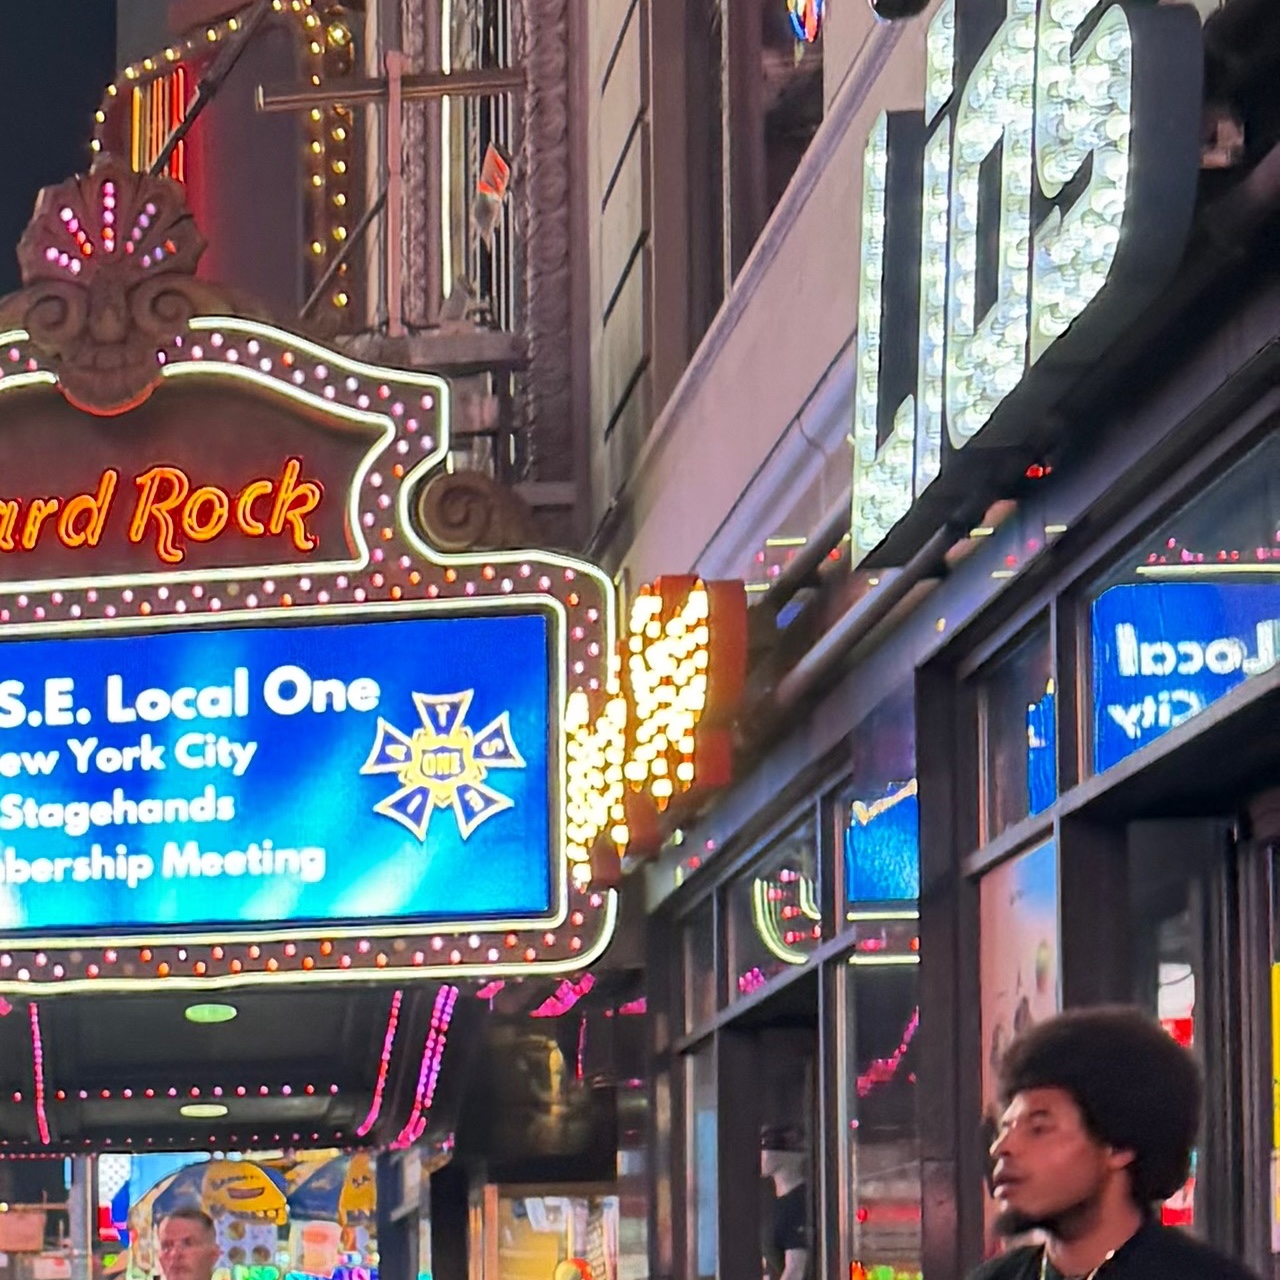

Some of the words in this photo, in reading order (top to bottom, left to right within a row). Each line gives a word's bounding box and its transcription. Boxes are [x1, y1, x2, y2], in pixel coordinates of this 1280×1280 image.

[129, 456, 321, 563] Rock
[107, 667, 249, 723] Local
[264, 665, 381, 715] One
[67, 735, 165, 774] York
[175, 732, 258, 775] City
[421, 751, 462, 777] ONE
[163, 839, 326, 883] Meeting
